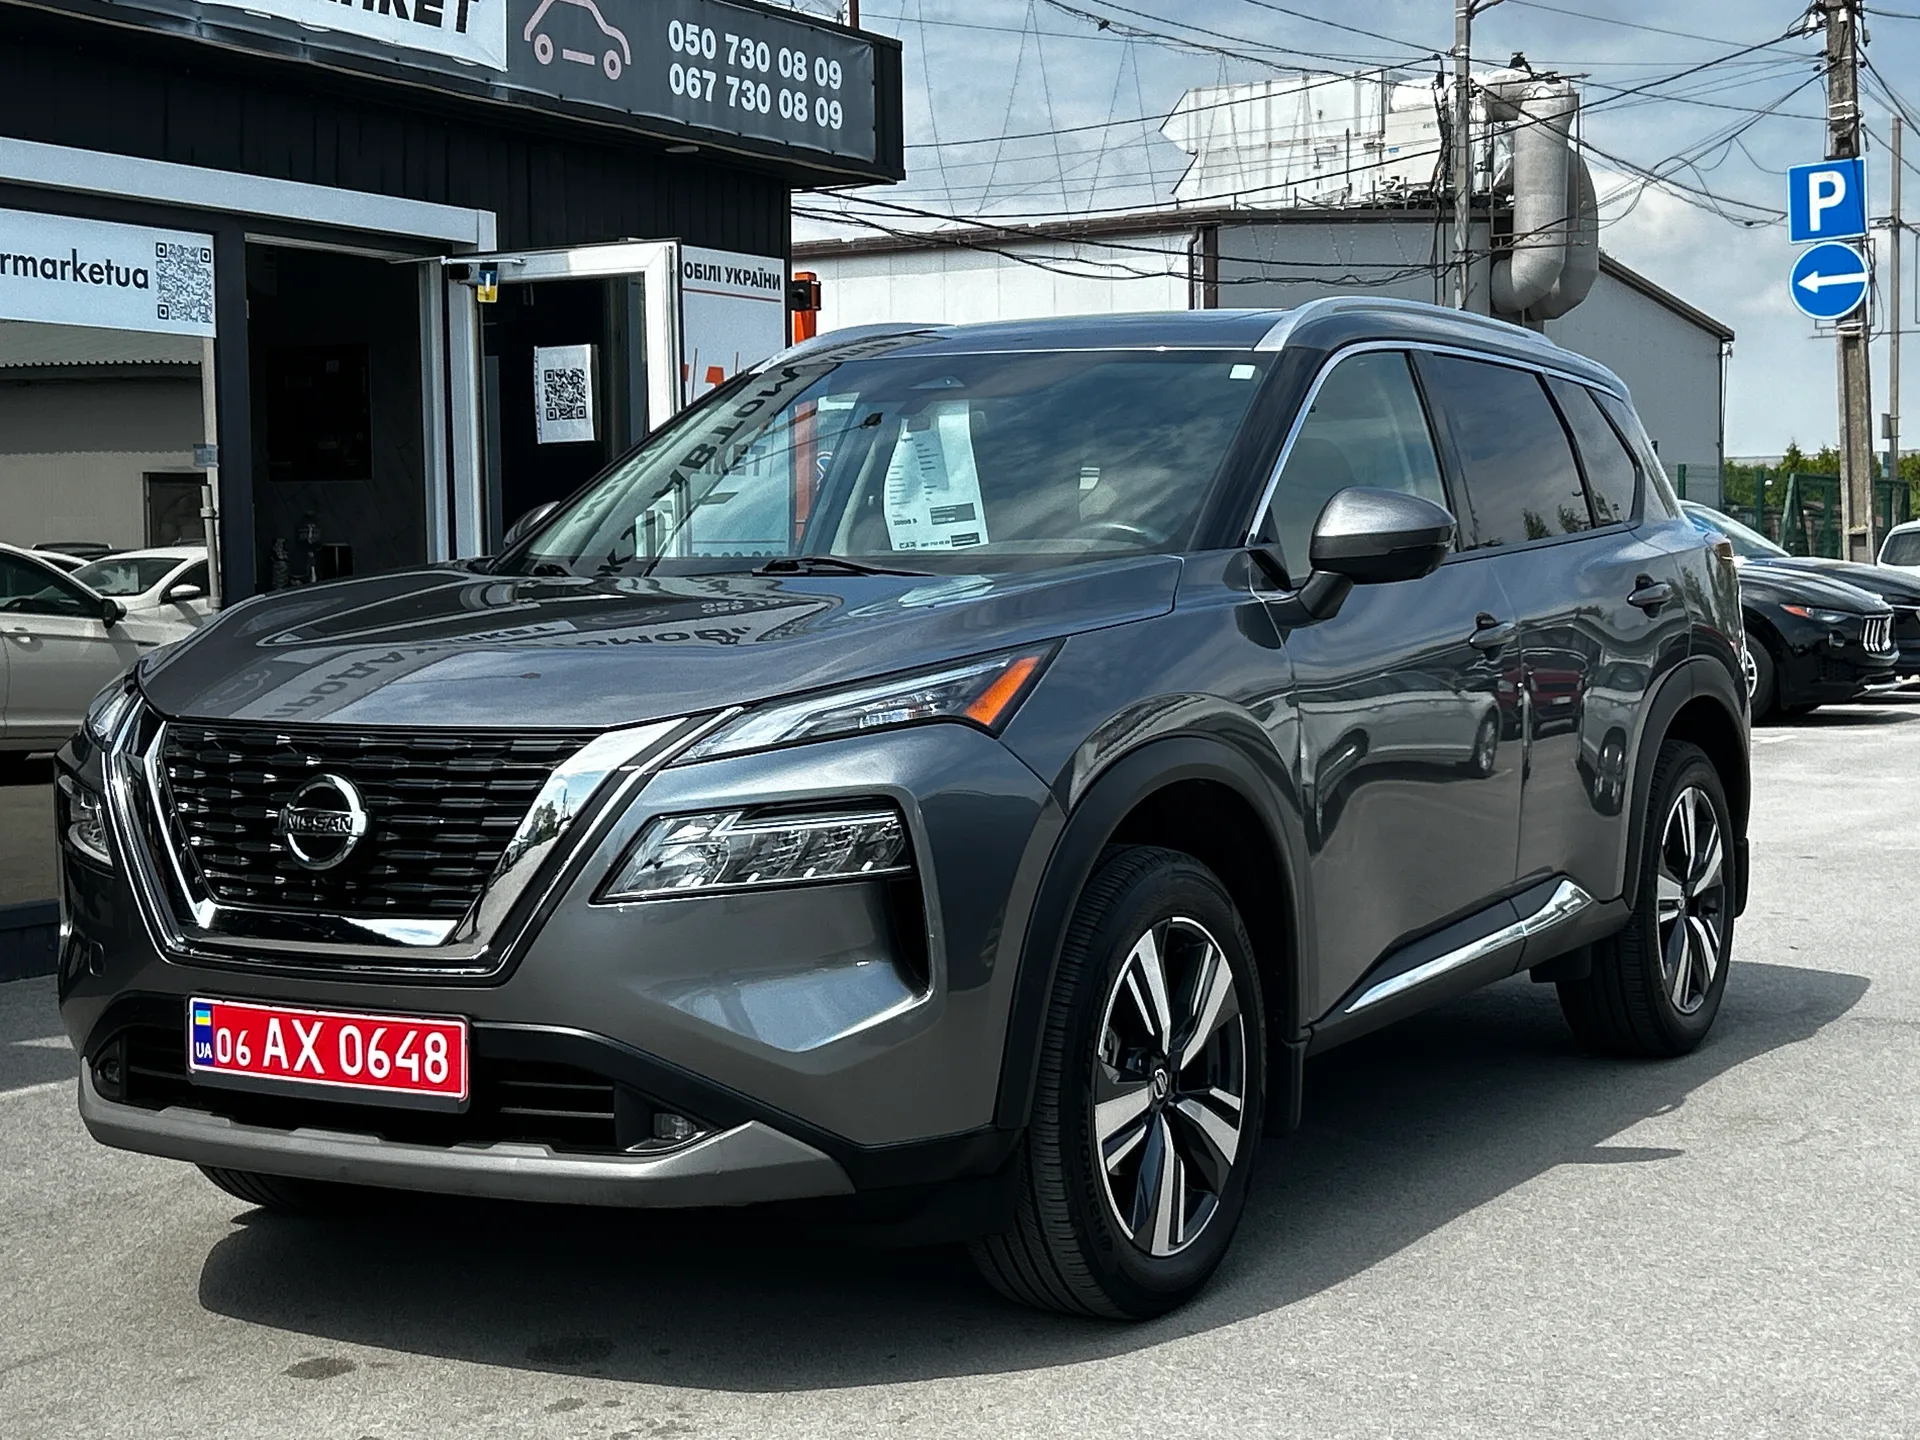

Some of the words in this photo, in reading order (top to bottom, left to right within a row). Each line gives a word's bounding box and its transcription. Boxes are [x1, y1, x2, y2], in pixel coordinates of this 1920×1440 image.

[668, 19, 717, 60] 050
[725, 33, 770, 73] 730
[778, 48, 807, 82] 08
[814, 57, 842, 90] 09
[669, 63, 717, 102] 067
[726, 75, 771, 114] 730
[779, 88, 808, 122] 08
[815, 97, 843, 130] 09
[1808, 170, 1846, 232] P
[683, 261, 721, 283] ОБІЛІ
[724, 267, 781, 291] УКРАЇНИ
[195, 1041, 213, 1059] UA
[216, 1027, 251, 1067] 06
[262, 1017, 325, 1075] AX
[338, 1024, 449, 1084] 0648
